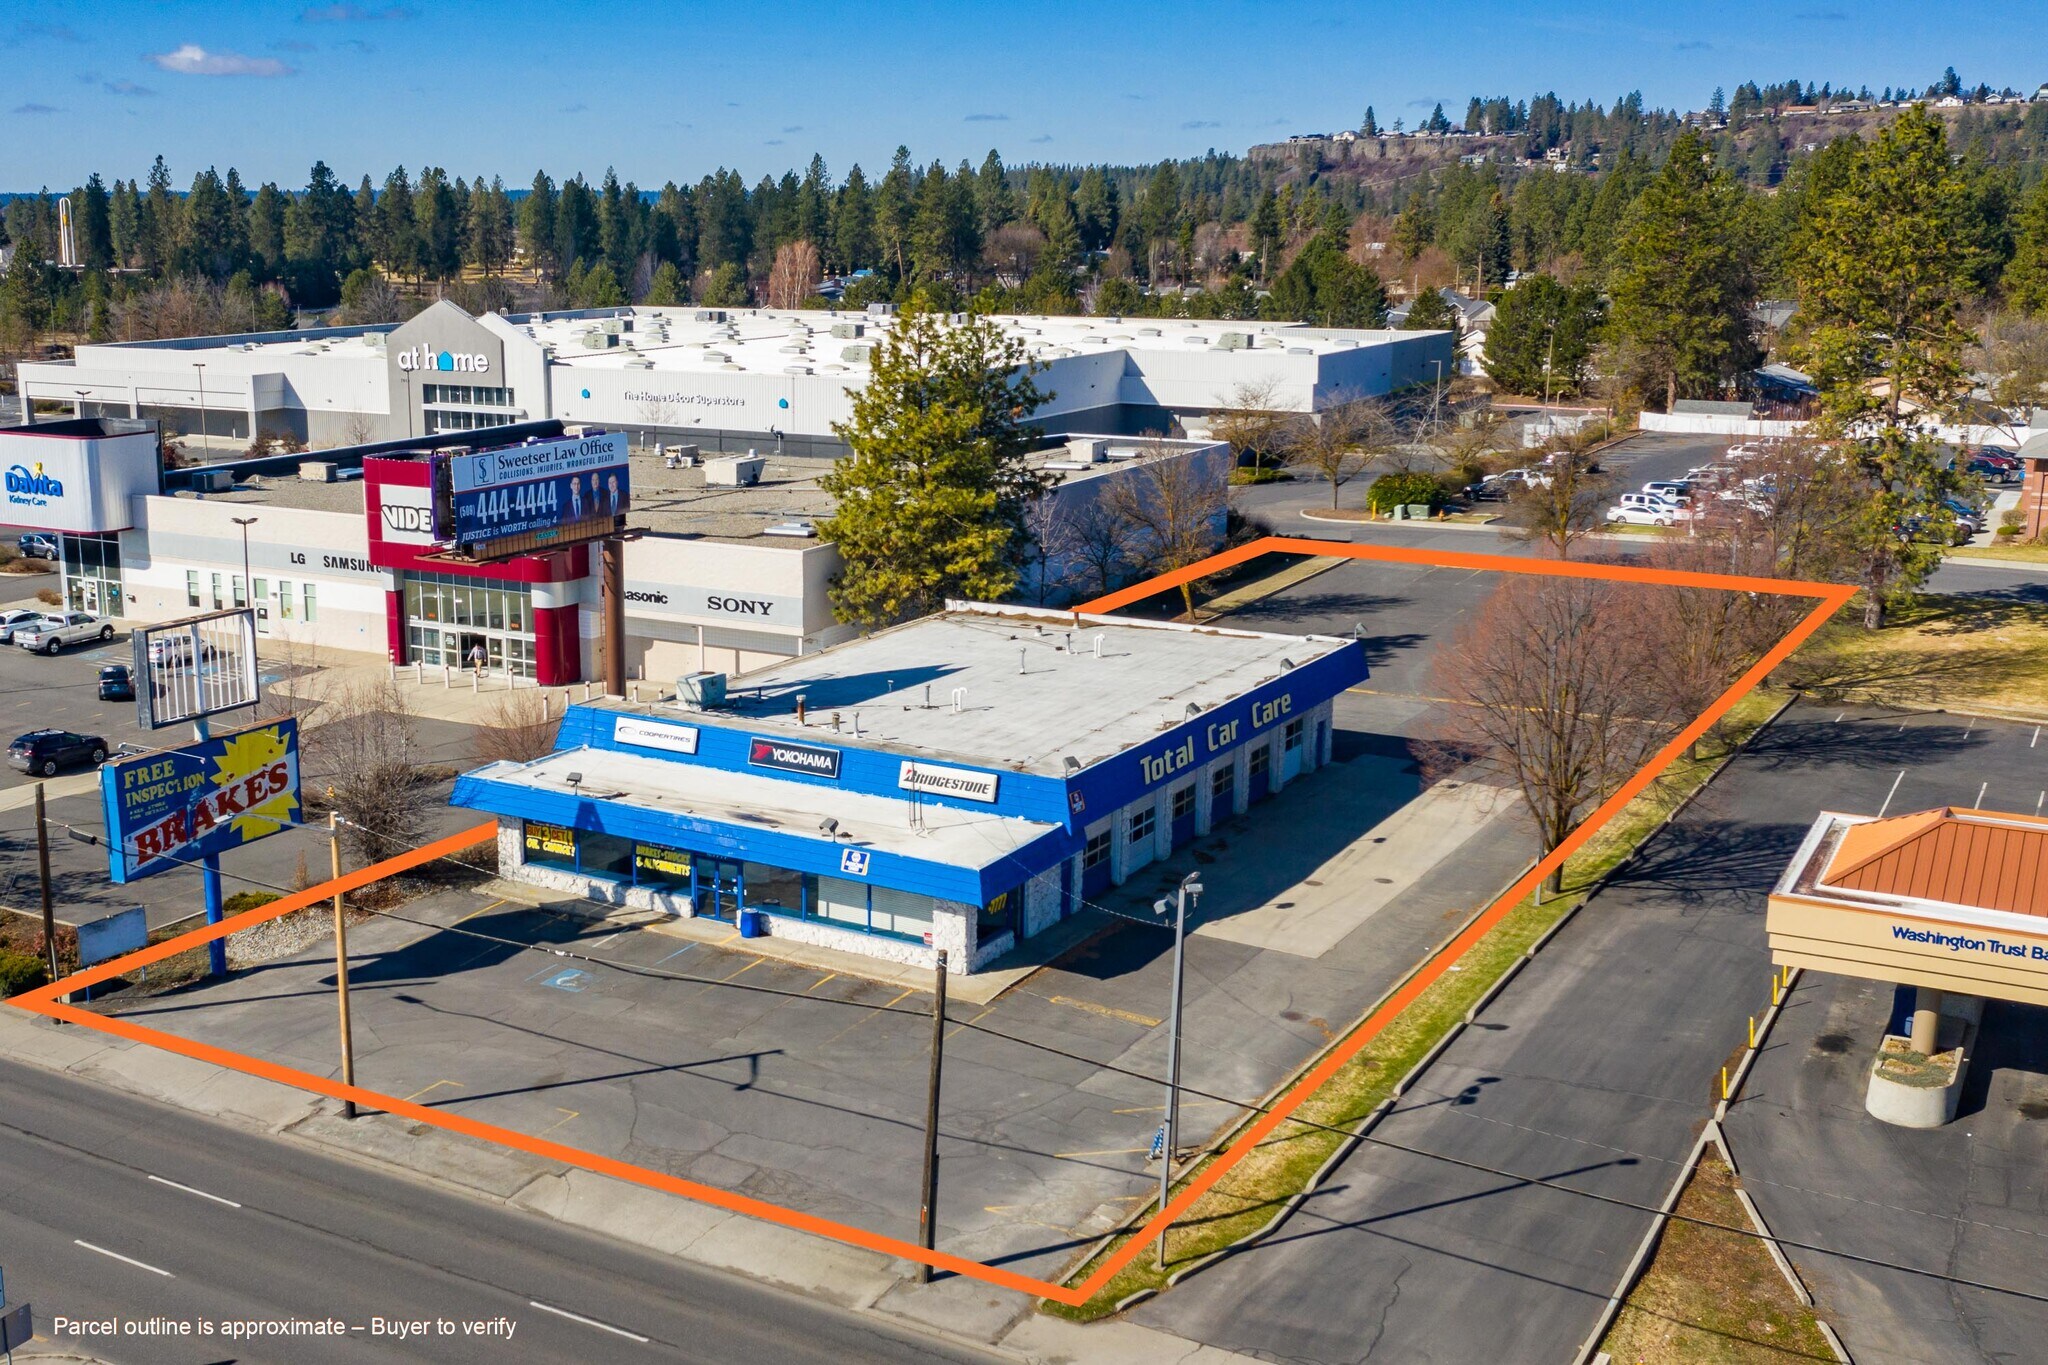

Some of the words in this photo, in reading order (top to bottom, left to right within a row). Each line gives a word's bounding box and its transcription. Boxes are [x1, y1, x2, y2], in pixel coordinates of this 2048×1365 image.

[397, 347, 420, 370] at
[623, 391, 639, 401] The
[640, 391, 667, 402] Home
[695, 394, 746, 407] Superstore
[498, 452, 551, 470] Sweetser
[554, 446, 578, 461] Law
[580, 439, 614, 457] Office
[499, 467, 535, 480] COLLISIONS,
[537, 462, 565, 474] INJURIES,
[566, 457, 595, 469] WRONGFUL
[598, 453, 614, 464] DEATH
[5, 464, 64, 498] DaVita
[9, 495, 31, 506] Kidney
[32, 497, 47, 507] Care
[476, 480, 558, 525] 444-4444
[381, 504, 434, 534] VIDE
[461, 528, 492, 543] JUSTICE
[493, 526, 499, 536] is
[501, 521, 527, 533] WORTH
[528, 517, 551, 530] calling
[552, 516, 558, 525] 4
[290, 552, 306, 565] LG
[707, 596, 774, 616] SONY
[1140, 735, 1194, 785] Total
[1207, 718, 1239, 752] Car
[1252, 693, 1292, 729] Care
[772, 749, 833, 770] YOKOHAMA
[123, 759, 175, 789] FREE
[903, 769, 991, 795] BRIDGESTONE
[134, 761, 289, 866] BRAKES
[526, 824, 541, 838] BUY
[541, 826, 551, 842] 3
[551, 828, 568, 844] GET
[1892, 925, 1985, 951] Washington
[1987, 938, 2027, 957] Trust
